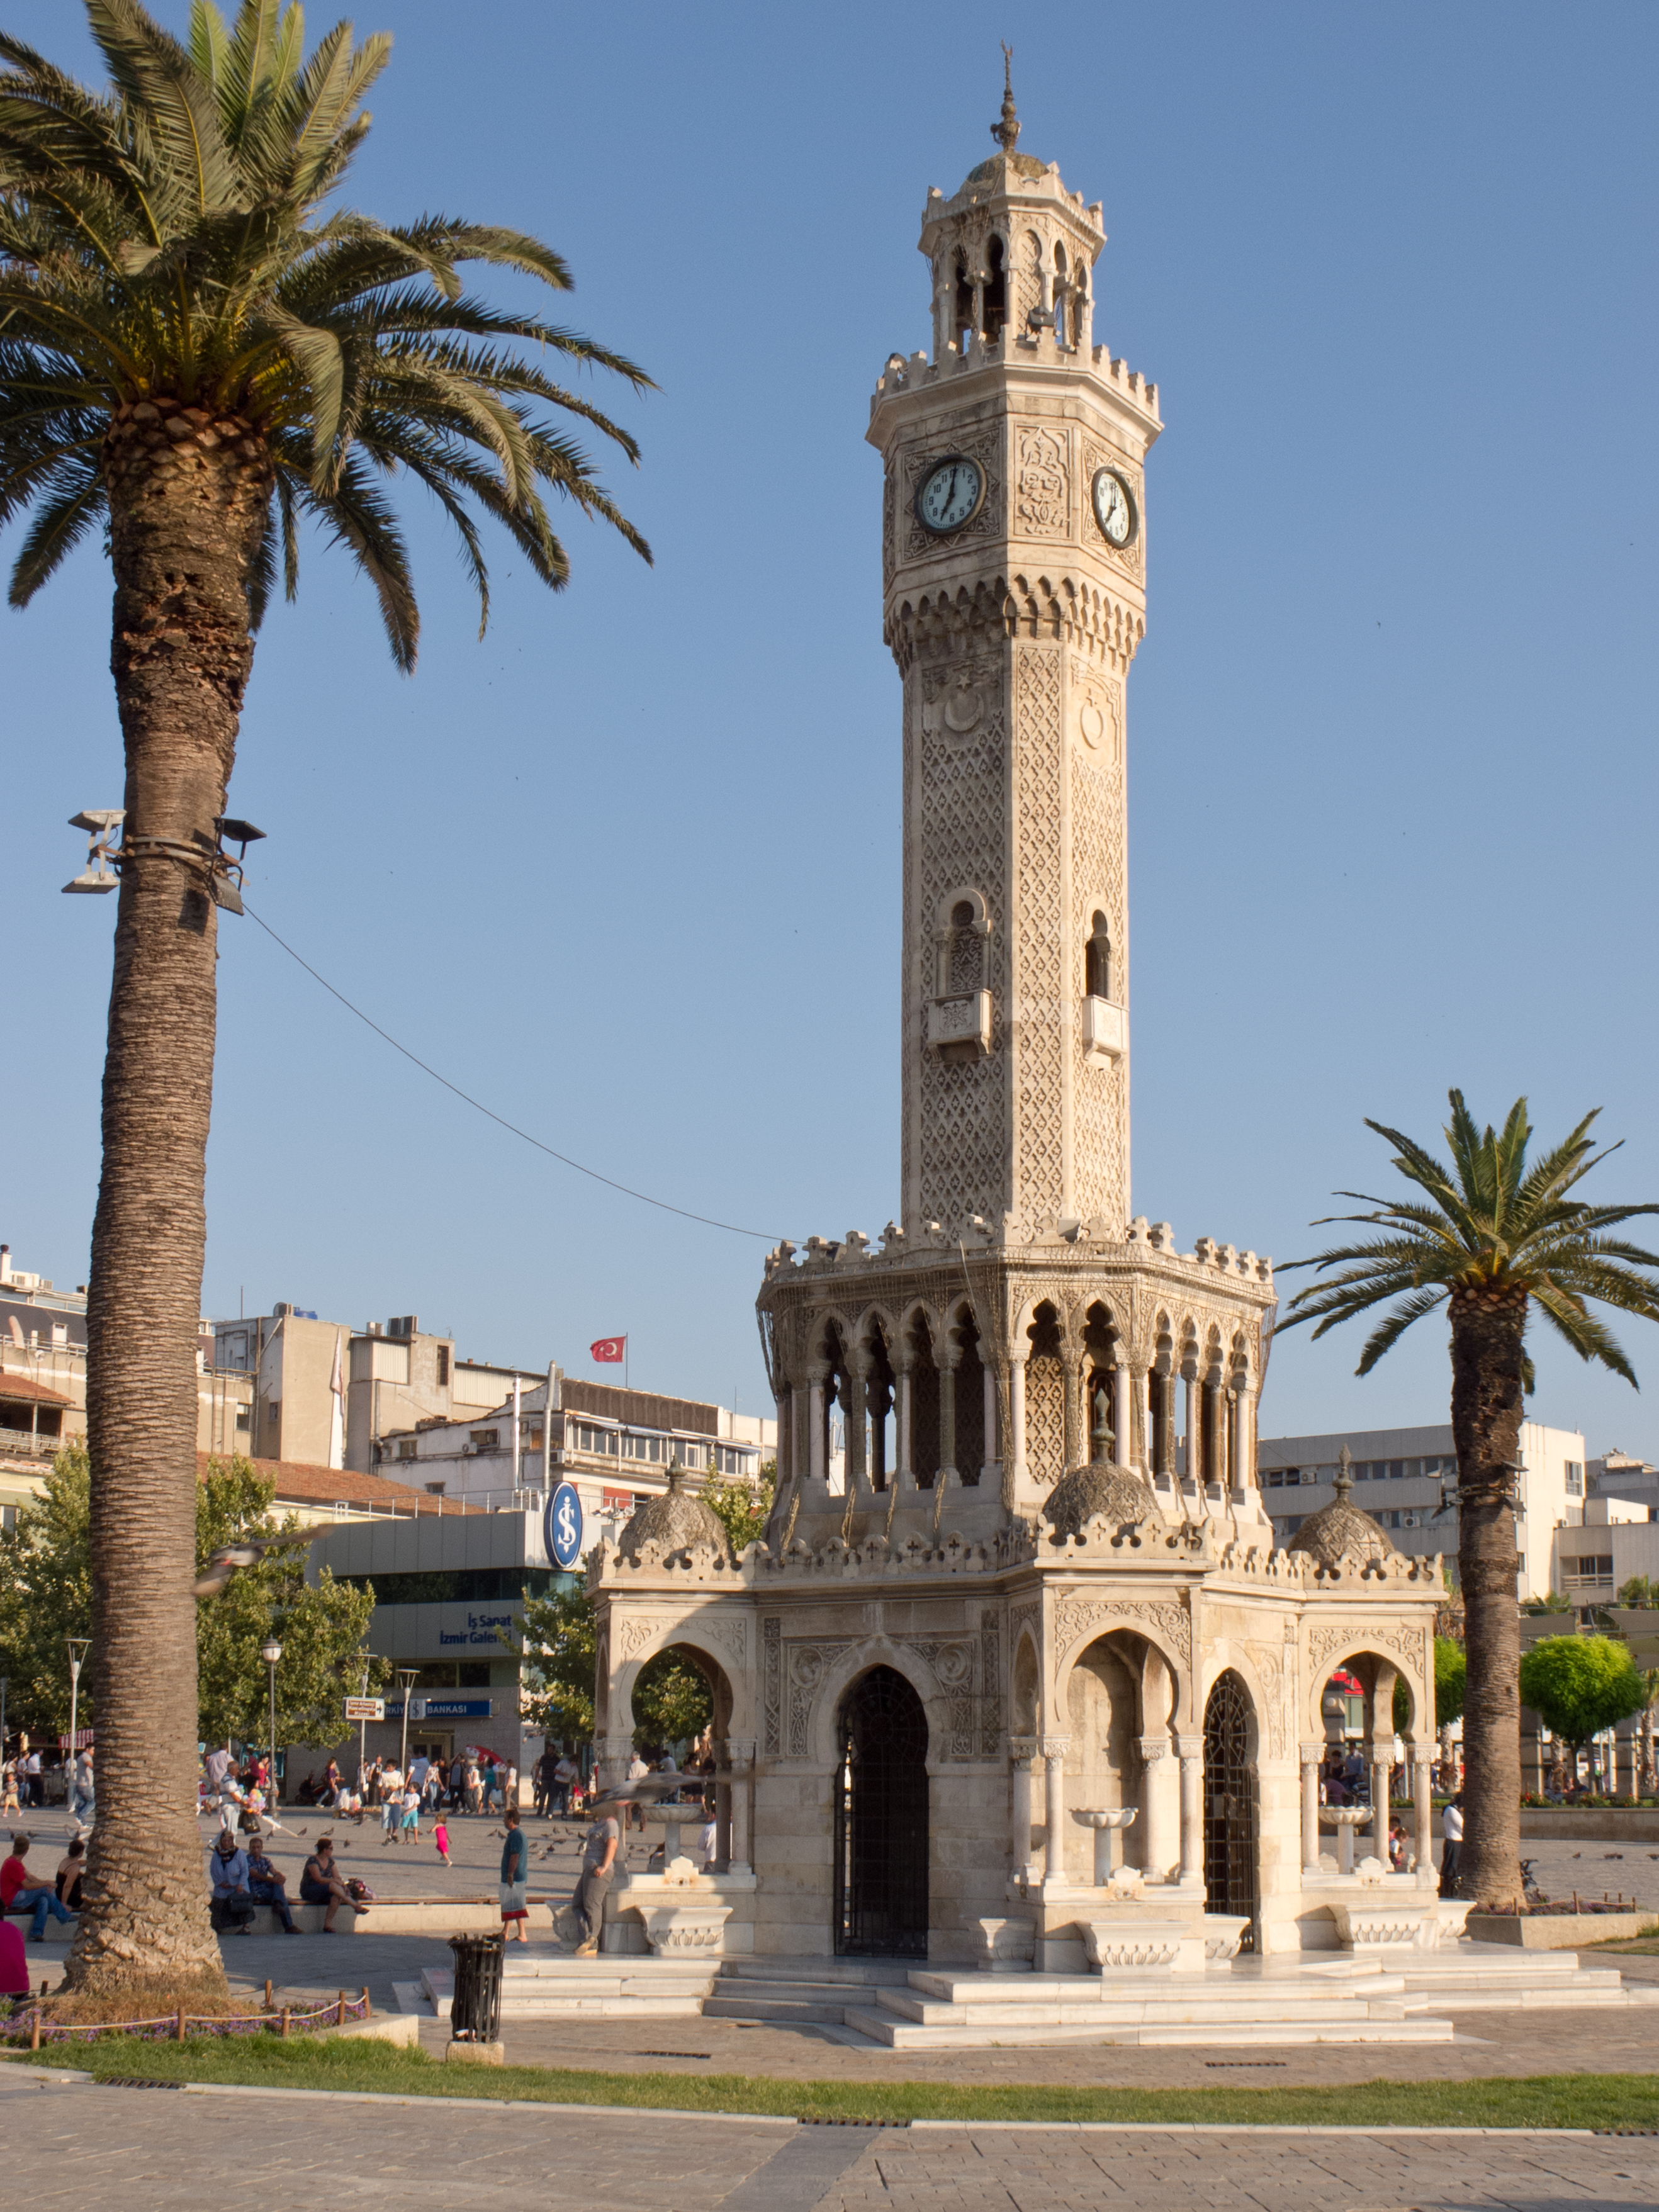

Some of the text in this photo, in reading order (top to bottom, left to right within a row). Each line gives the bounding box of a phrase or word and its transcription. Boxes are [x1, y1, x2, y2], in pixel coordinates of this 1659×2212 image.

[942, 474, 947, 483] 11
[962, 469, 965, 478] 1
[967, 474, 973, 484] 2
[933, 483, 942, 494] 10
[971, 485, 977, 495] 3
[928, 496, 934, 506] 9
[967, 498, 972, 508] 4
[933, 507, 938, 517] 8
[959, 507, 965, 516] 5
[949, 513, 955, 522] 6
[468, 1612, 512, 1630] İş Sanat
[440, 1630, 512, 1644] İzmir Galeri
[427, 1705, 467, 1714] BANKASI
